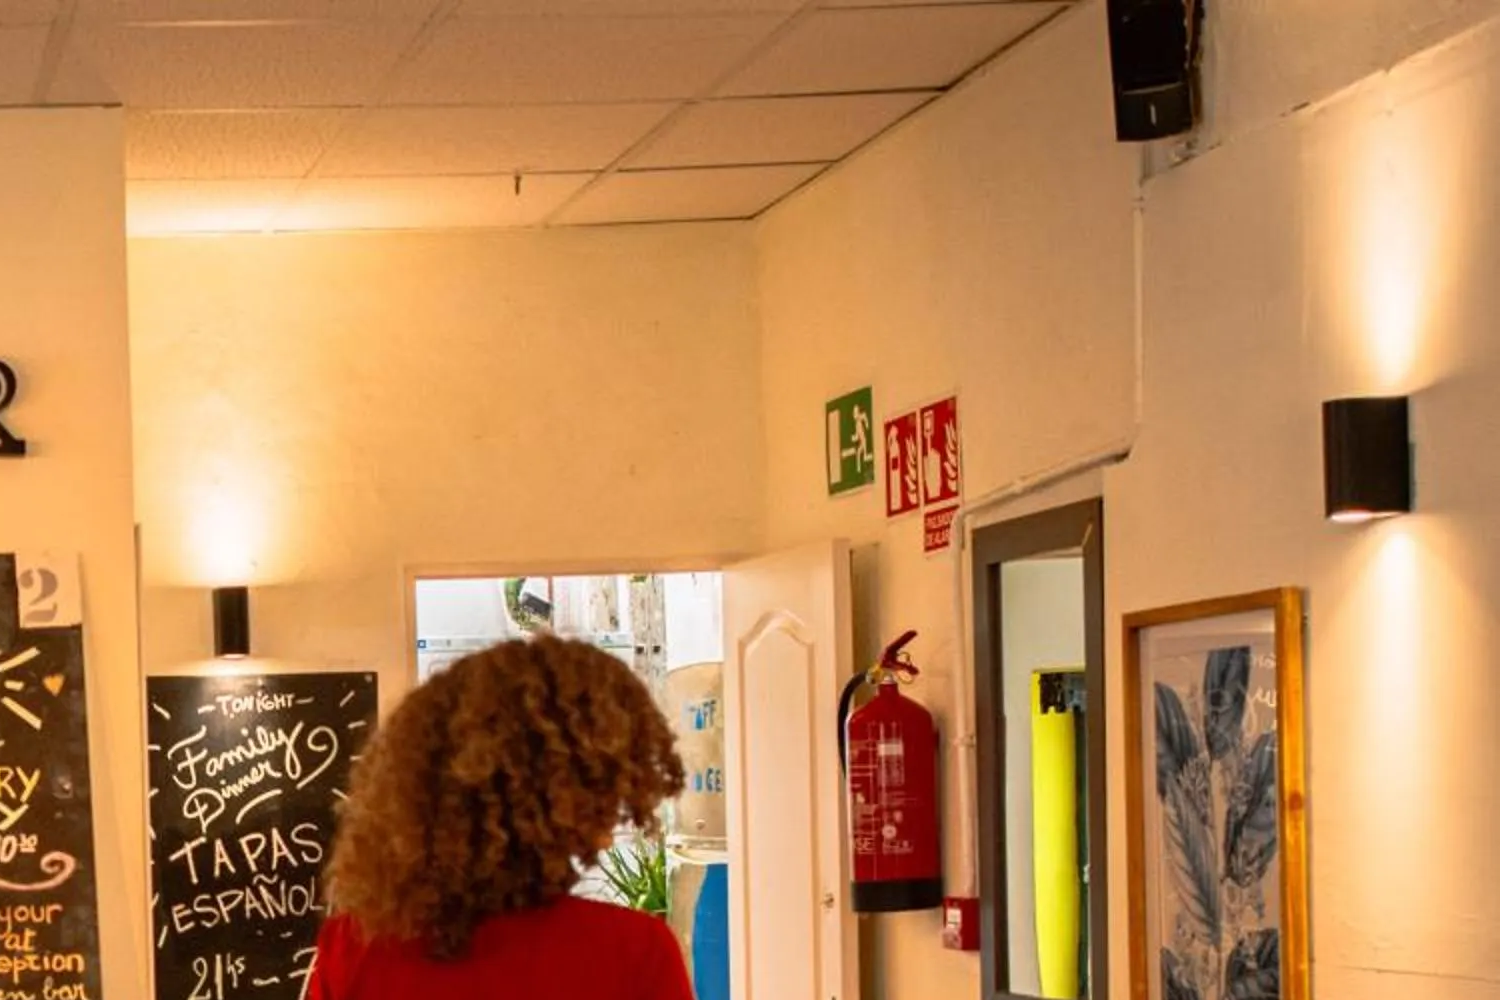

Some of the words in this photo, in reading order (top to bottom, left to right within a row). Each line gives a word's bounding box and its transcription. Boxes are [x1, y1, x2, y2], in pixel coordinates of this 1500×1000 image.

[18, 567, 59, 623] 2
[167, 721, 304, 789] Family
[183, 760, 283, 834] Dinner
[168, 822, 324, 885] TAPAS
[4, 927, 37, 951] at
